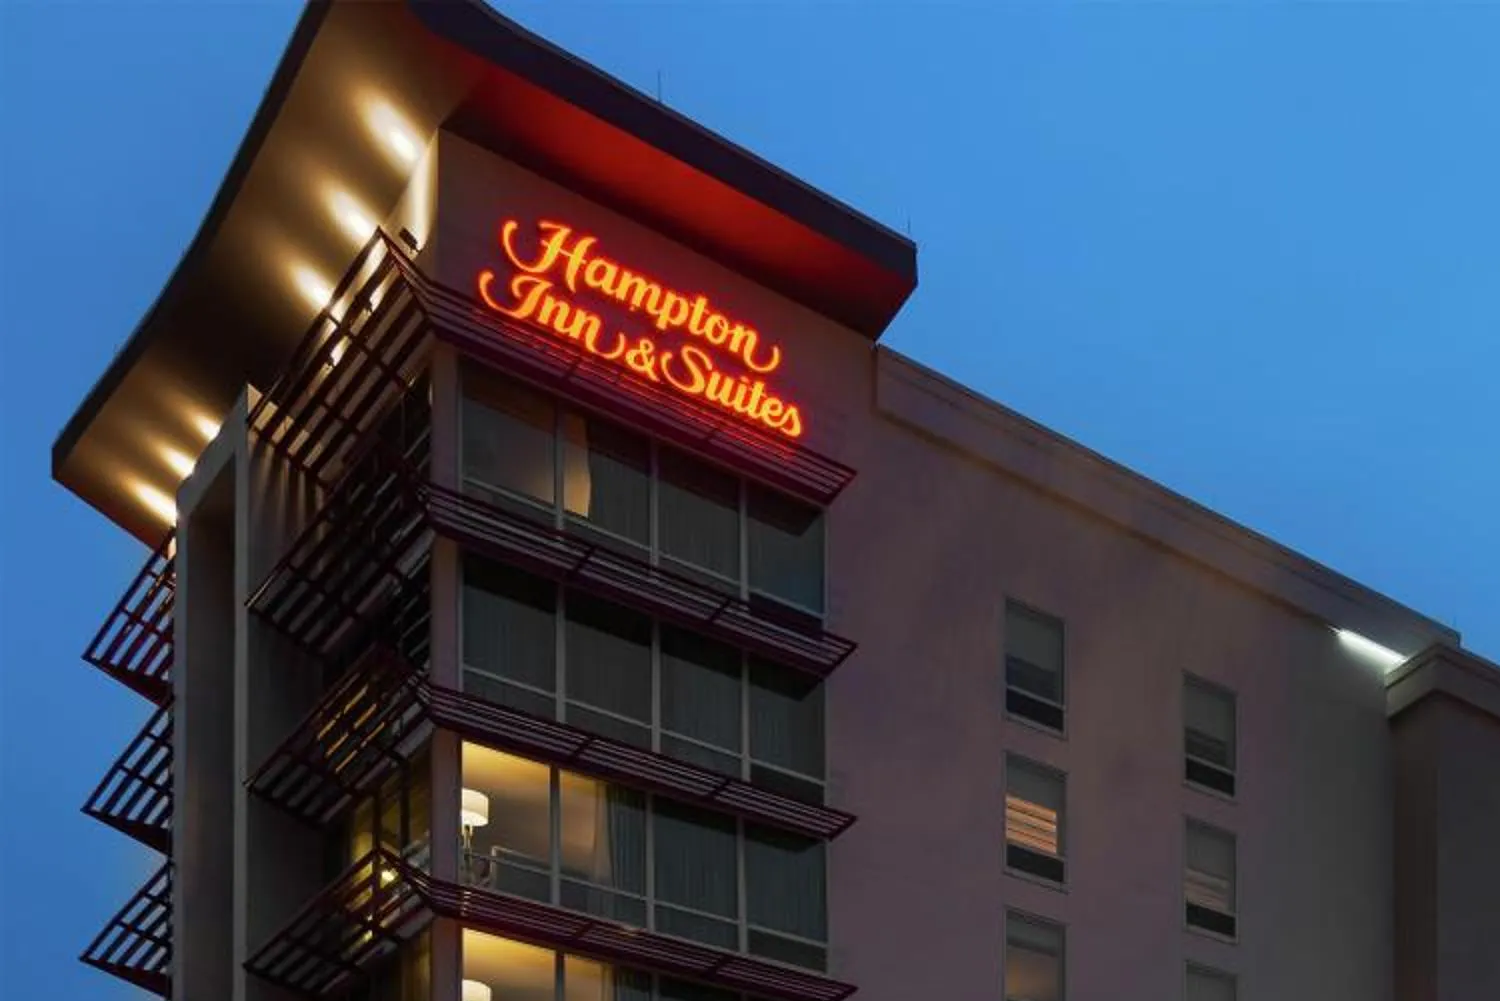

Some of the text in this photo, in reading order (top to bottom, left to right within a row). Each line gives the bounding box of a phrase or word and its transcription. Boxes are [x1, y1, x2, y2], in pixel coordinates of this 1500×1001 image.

[477, 270, 803, 438] Inn & Suites
[501, 219, 781, 373] Hampton
